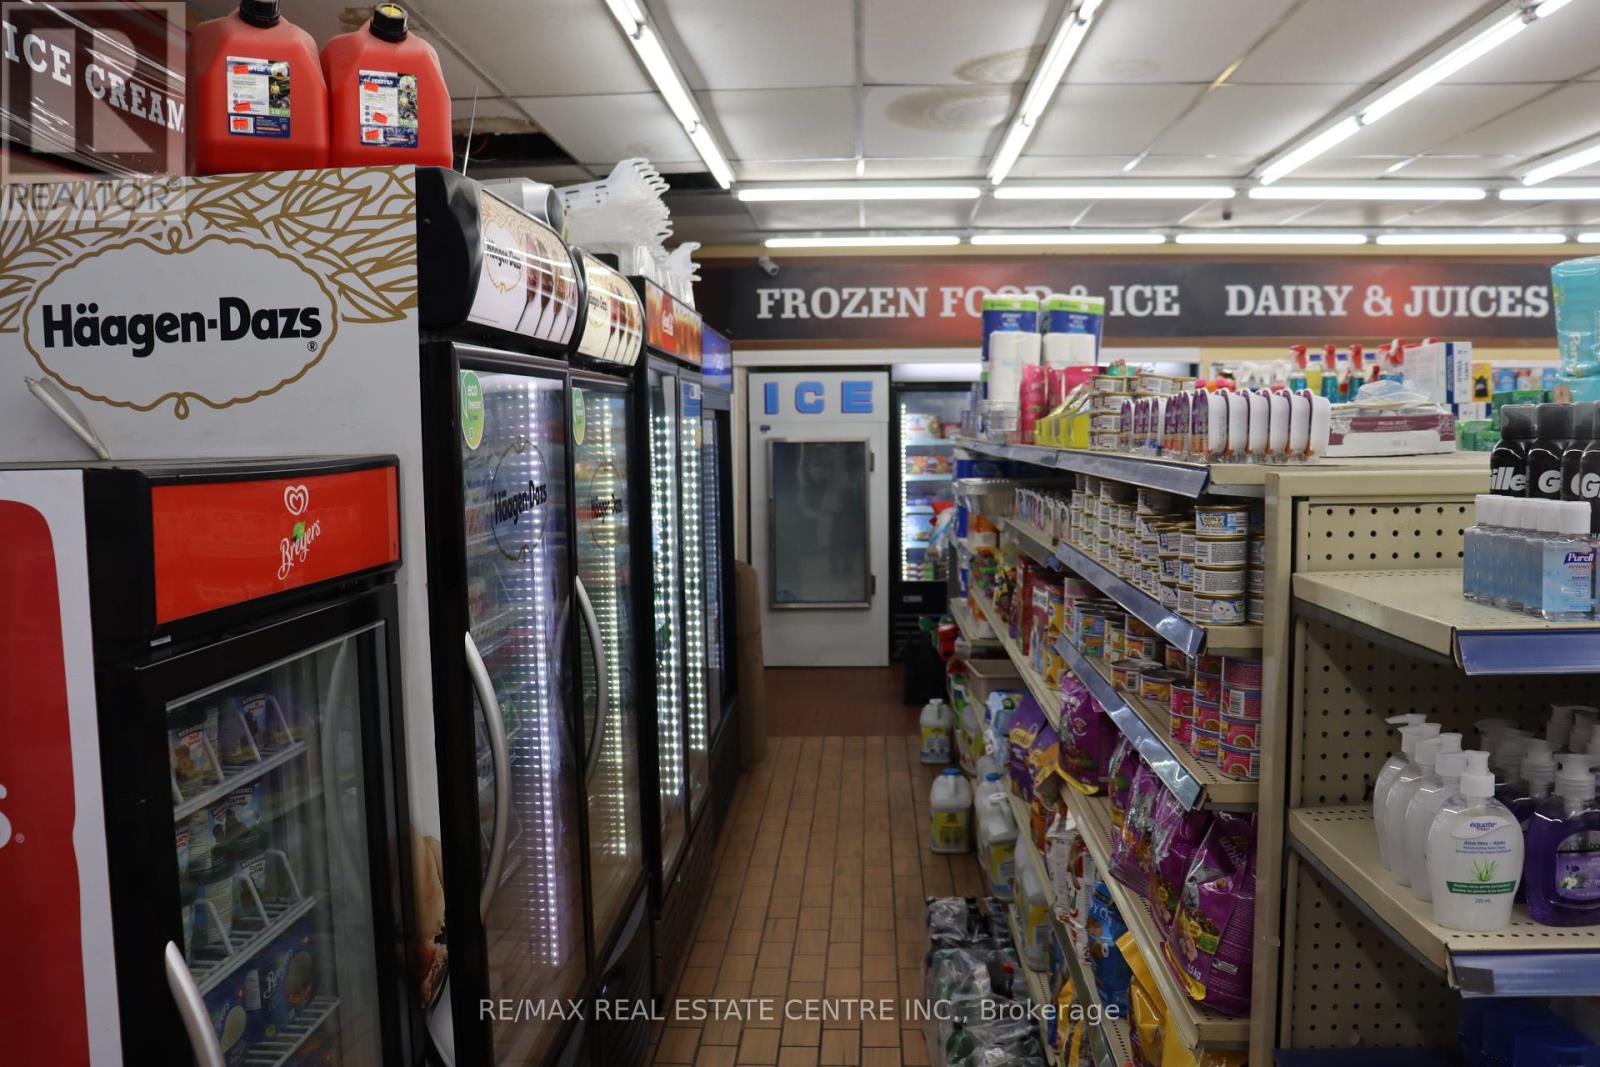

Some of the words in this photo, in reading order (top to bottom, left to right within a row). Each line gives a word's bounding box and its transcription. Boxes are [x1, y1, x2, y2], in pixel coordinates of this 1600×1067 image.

[2, 20, 72, 86] ICE
[85, 63, 185, 134] CREAM
[757, 287, 928, 319] FROZEN
[1110, 285, 1181, 317] ICE
[1225, 285, 1353, 317] DAIRY
[1363, 285, 1393, 318] &
[1405, 286, 1549, 318] JUICES
[42, 297, 322, 358] Häagen-Dazs
[764, 380, 873, 415] ICE
[494, 480, 548, 525] Häagen-Dazs
[278, 519, 321, 581] Breyers
[1568, 553, 1594, 562] Purell
